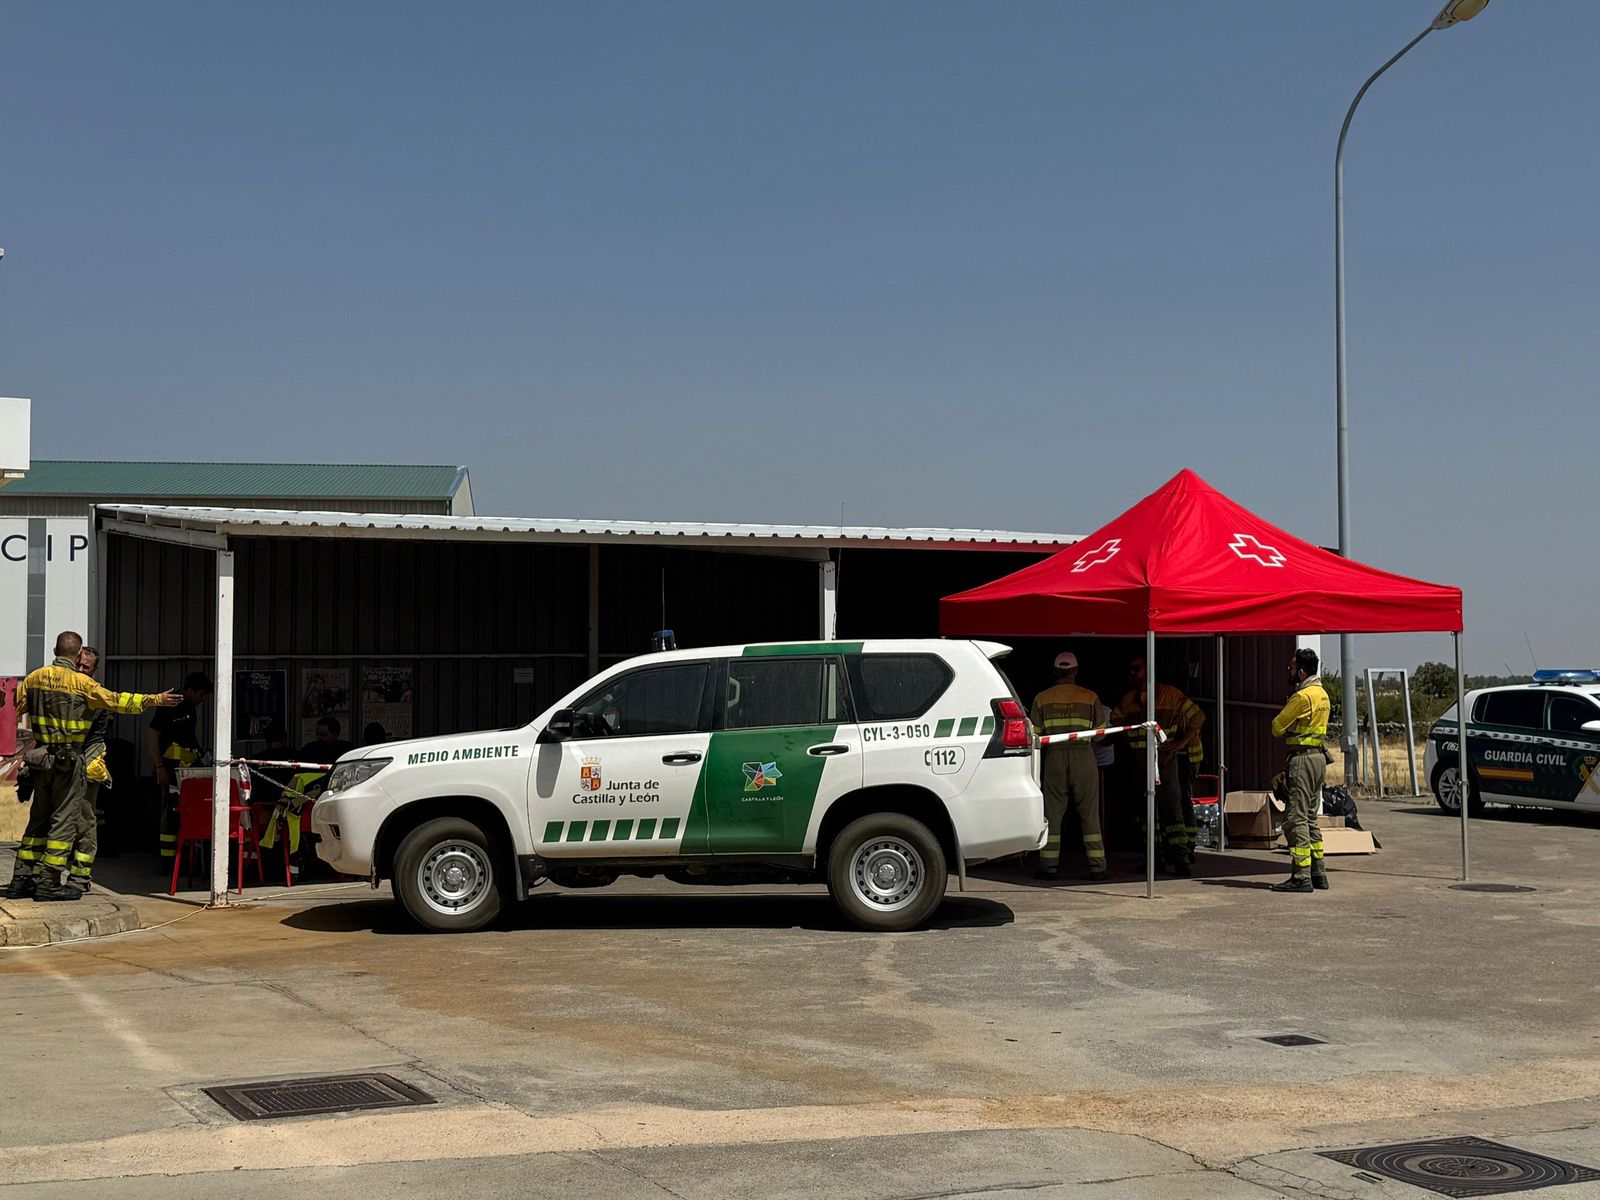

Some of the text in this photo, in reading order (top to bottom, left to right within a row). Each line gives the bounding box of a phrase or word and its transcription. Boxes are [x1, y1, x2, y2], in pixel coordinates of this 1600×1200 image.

[863, 723, 930, 742] CYL-3-050
[408, 745, 519, 765] MEDIO AMBIENTE
[934, 750, 956, 765] 112
[1484, 750, 1567, 766] GUARDIA CIVIL
[606, 780, 660, 790] Junta de
[572, 793, 660, 806] Castilla y León
